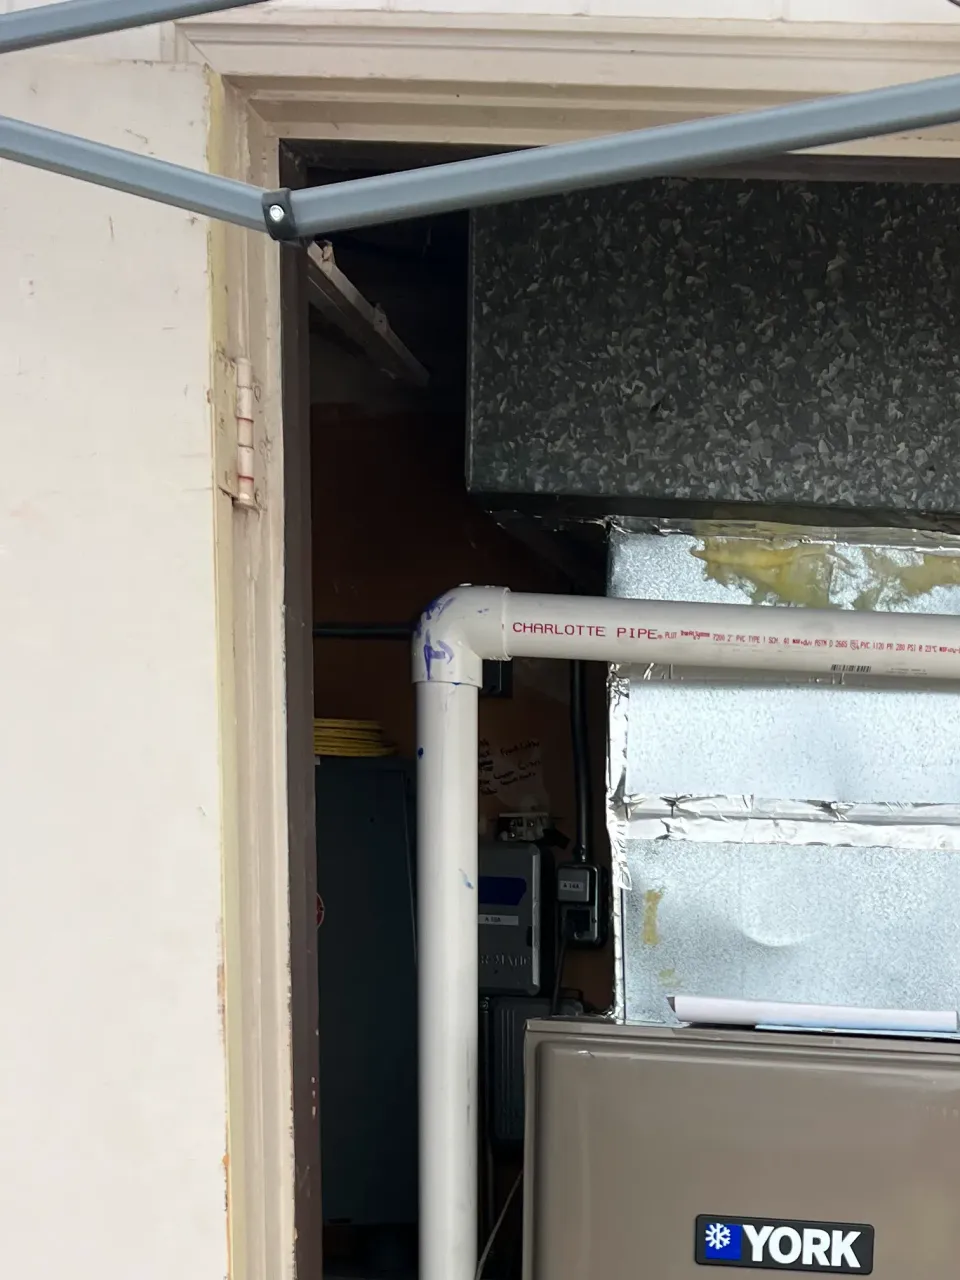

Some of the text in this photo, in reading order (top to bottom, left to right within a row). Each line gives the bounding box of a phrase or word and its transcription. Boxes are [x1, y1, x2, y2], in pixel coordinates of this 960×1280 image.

[512, 622, 606, 637] CHARLOTTE
[736, 634, 746, 643] PVC
[748, 635, 760, 644] TYPE
[860, 641, 870, 649] PVC
[872, 642, 884, 650] 1120
[742, 1224, 862, 1268] YORK
